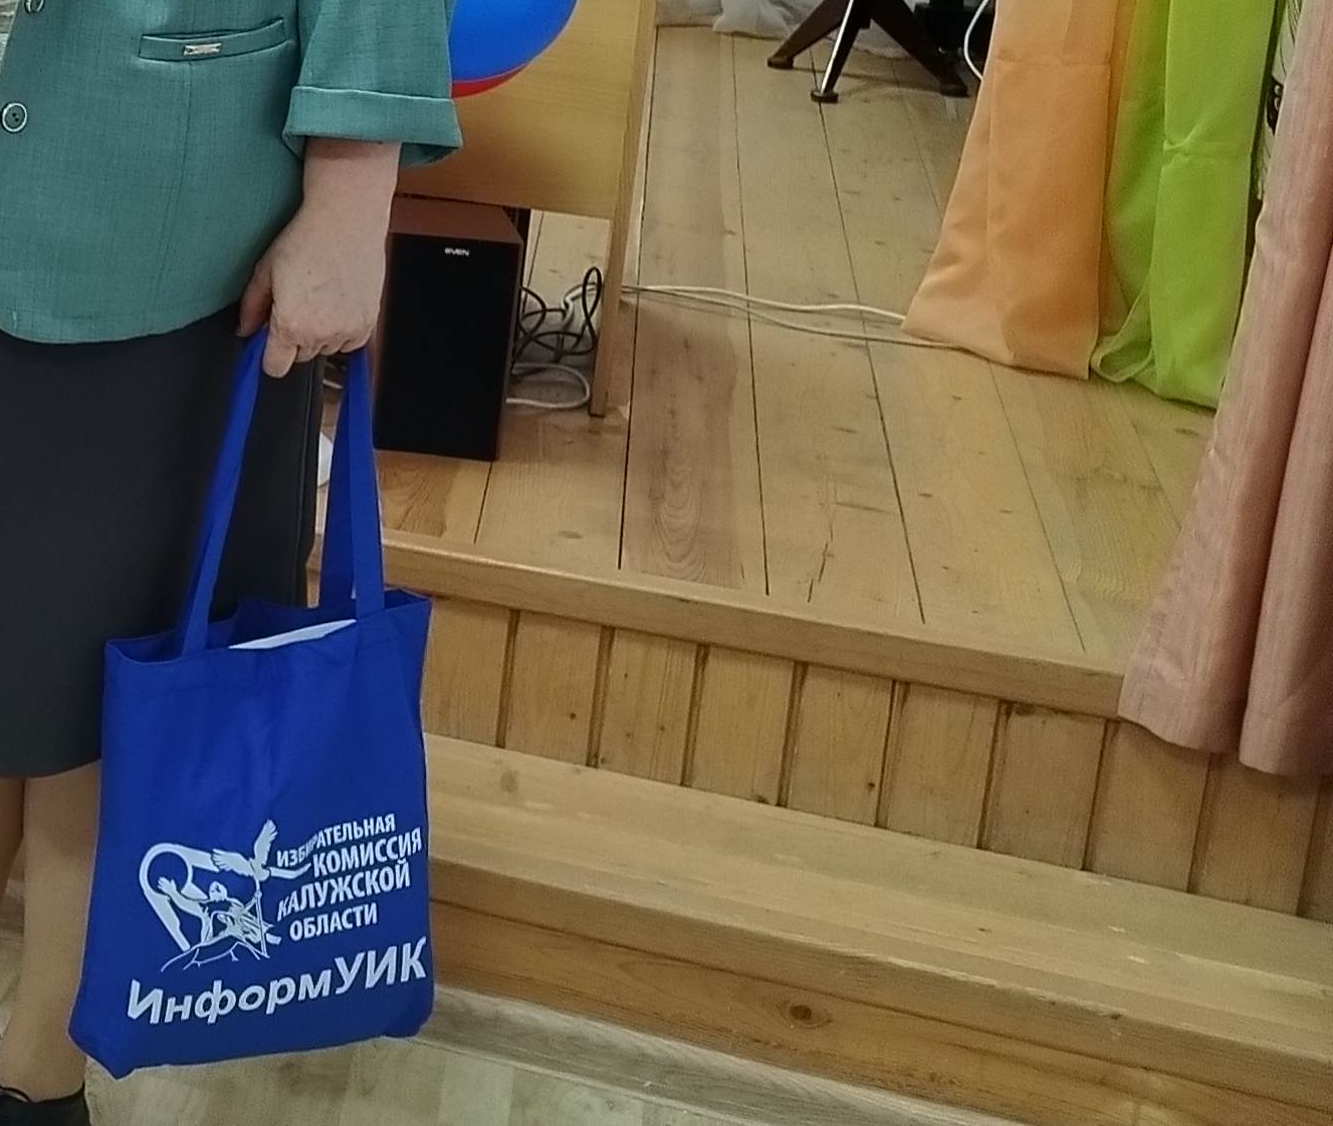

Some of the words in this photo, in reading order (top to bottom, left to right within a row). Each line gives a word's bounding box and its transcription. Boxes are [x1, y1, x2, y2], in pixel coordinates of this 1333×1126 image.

[276, 813, 396, 868] ИЗБИРАТЕЛЬНАЯ
[313, 827, 422, 878] КОМИССИЯ
[277, 858, 411, 922] КАЛУЖСКОЙ
[289, 902, 378, 942] ОБЛАСТИ
[126, 936, 427, 1025] ИнформУИК
